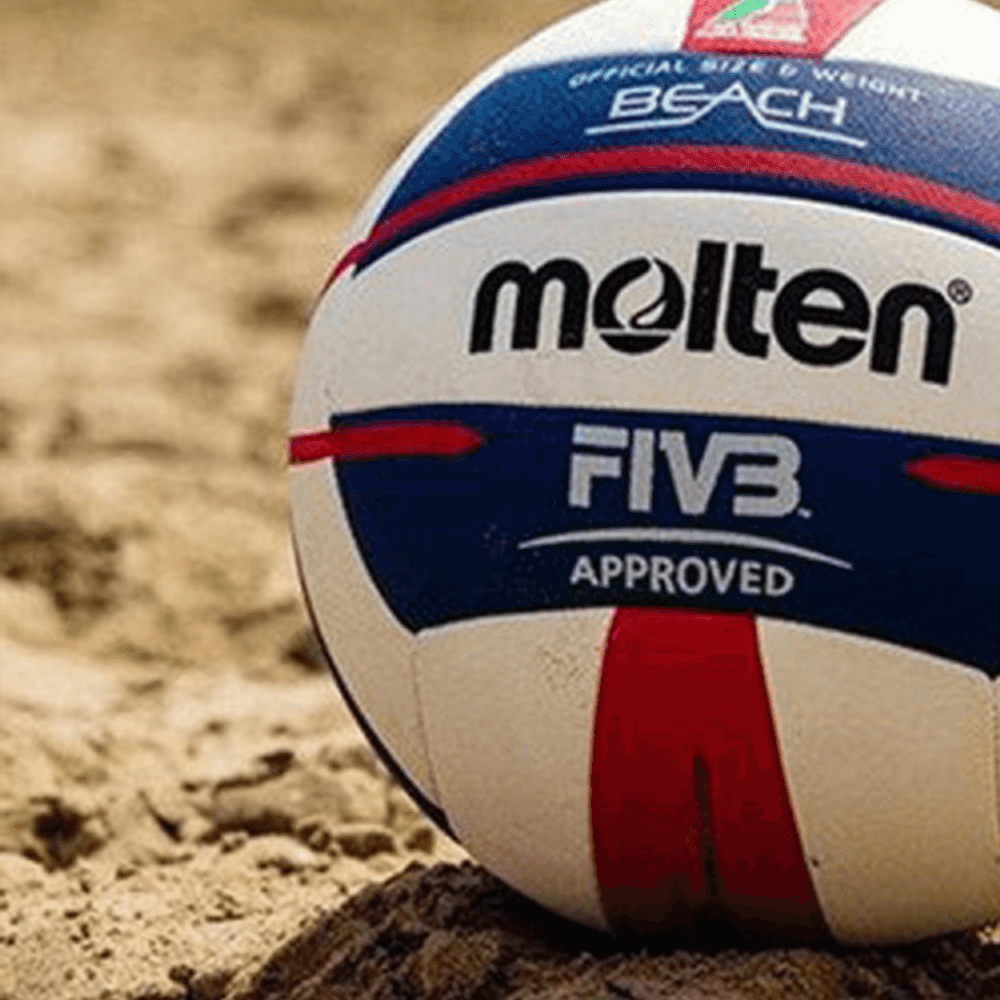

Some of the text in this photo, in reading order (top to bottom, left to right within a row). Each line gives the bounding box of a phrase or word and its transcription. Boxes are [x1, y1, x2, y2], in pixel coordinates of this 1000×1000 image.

[569, 59, 687, 88] OFFICIAL
[700, 59, 768, 75] SIZE
[812, 65, 921, 102] WEIGHT
[608, 80, 849, 127] BEACH
[567, 423, 802, 518] FIVB
[569, 555, 796, 598] APPROVED
